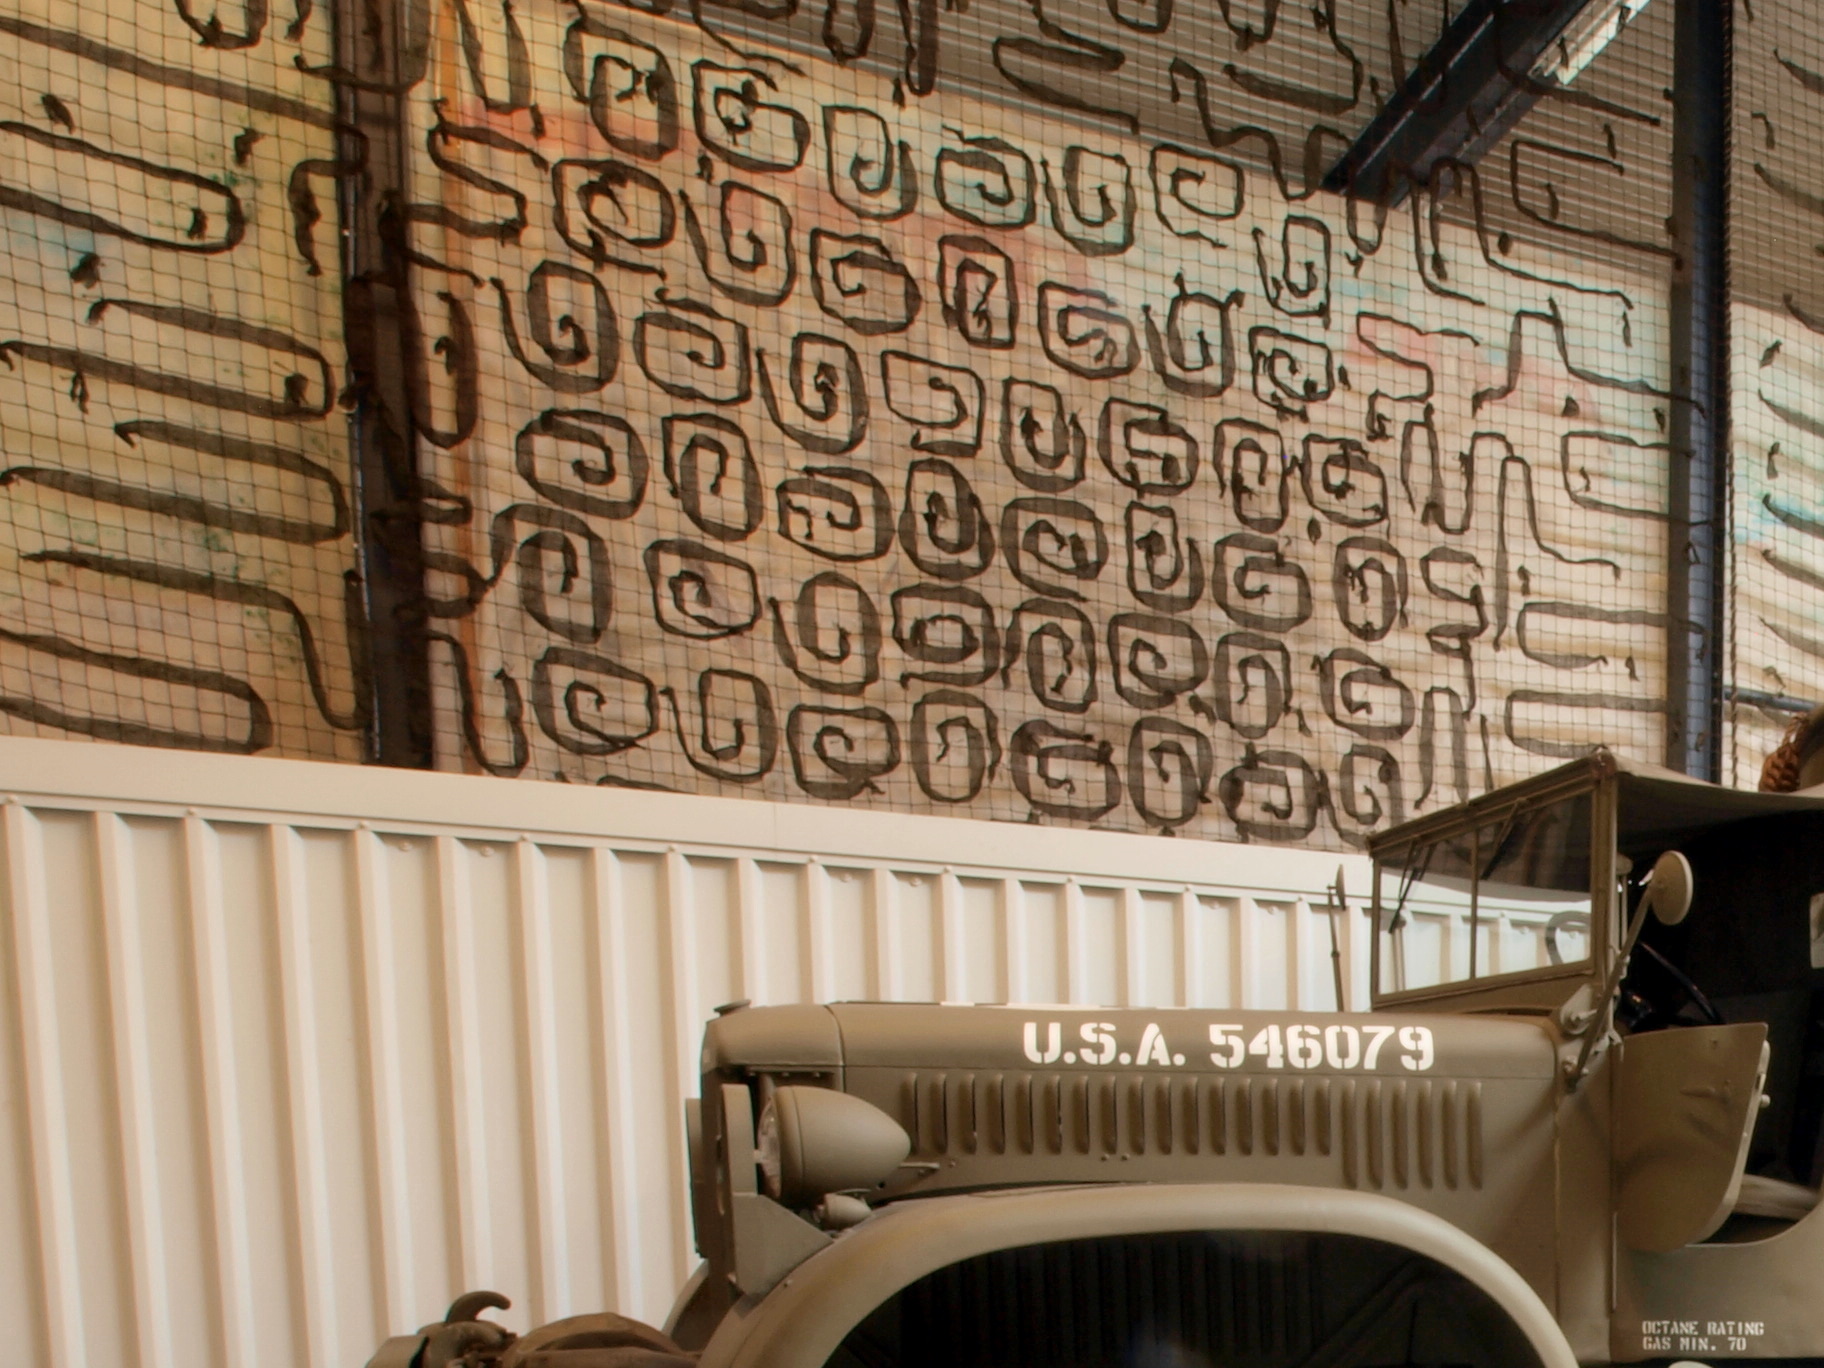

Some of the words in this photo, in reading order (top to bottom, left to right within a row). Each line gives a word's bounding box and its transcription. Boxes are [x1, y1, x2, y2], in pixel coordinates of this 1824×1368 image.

[1023, 1021, 1186, 1066] U.S.A.
[1208, 1023, 1435, 1071] 546079
[1642, 1320, 1699, 1335] OCTANE
[1707, 1321, 1765, 1336] RATING
[1642, 1337, 1671, 1351] GAS
[1679, 1337, 1716, 1351] MIN.
[1727, 1337, 1746, 1351] 70
